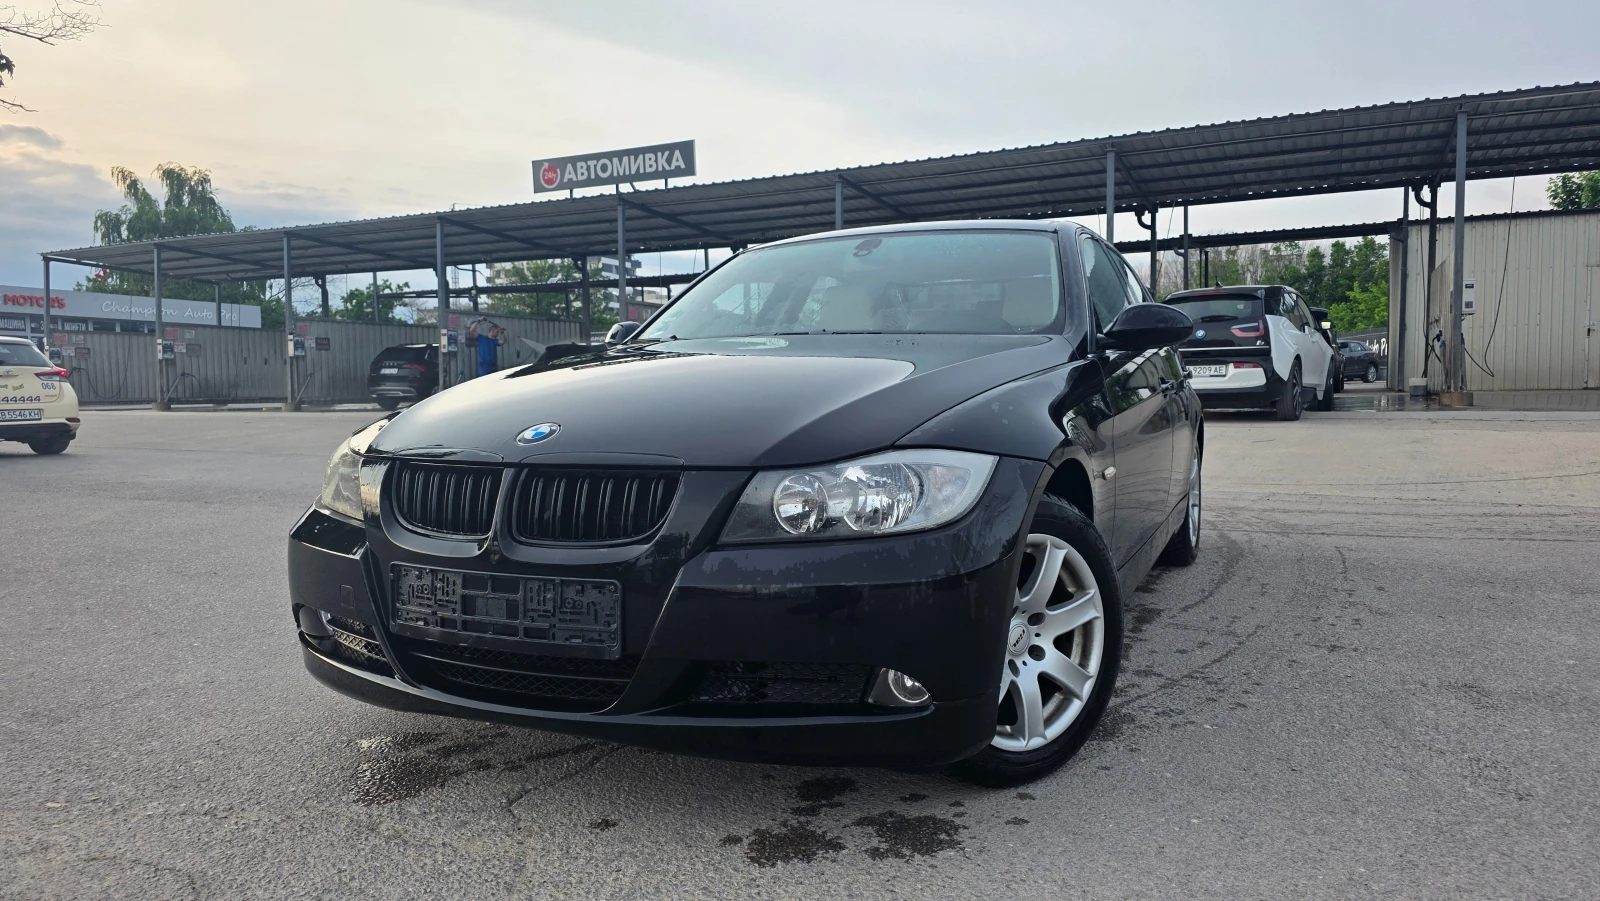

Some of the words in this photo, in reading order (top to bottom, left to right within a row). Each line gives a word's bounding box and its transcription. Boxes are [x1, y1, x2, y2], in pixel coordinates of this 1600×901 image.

[563, 149, 686, 182] АВТОМИВКА
[183, 306, 213, 320] Auto
[1192, 366, 1213, 375] 9209
[1213, 366, 1225, 374] AE
[41, 382, 57, 390] 068
[7, 410, 28, 419] 5546
[28, 410, 40, 418] KH
